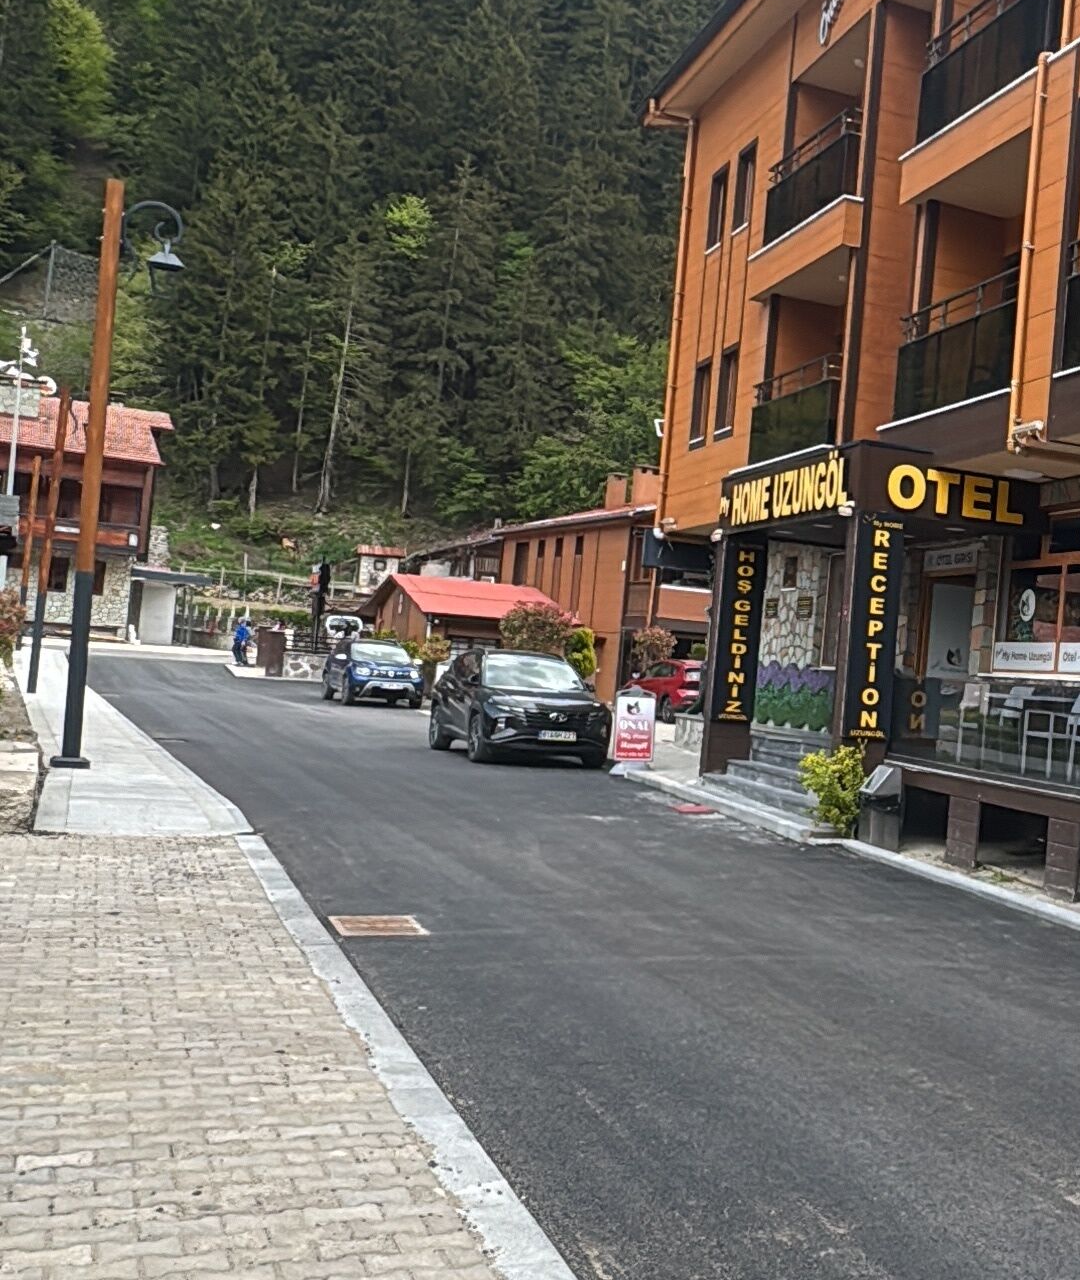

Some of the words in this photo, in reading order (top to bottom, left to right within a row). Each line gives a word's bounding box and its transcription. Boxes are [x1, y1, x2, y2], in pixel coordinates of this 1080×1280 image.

[731, 477, 770, 526] HOME
[773, 450, 848, 519] UZUNGÖL
[887, 464, 1024, 525] OTEL
[737, 550, 755, 594] HOŞ
[725, 599, 752, 713] GELDİNİZ
[1062, 651, 1077, 662] Otel
